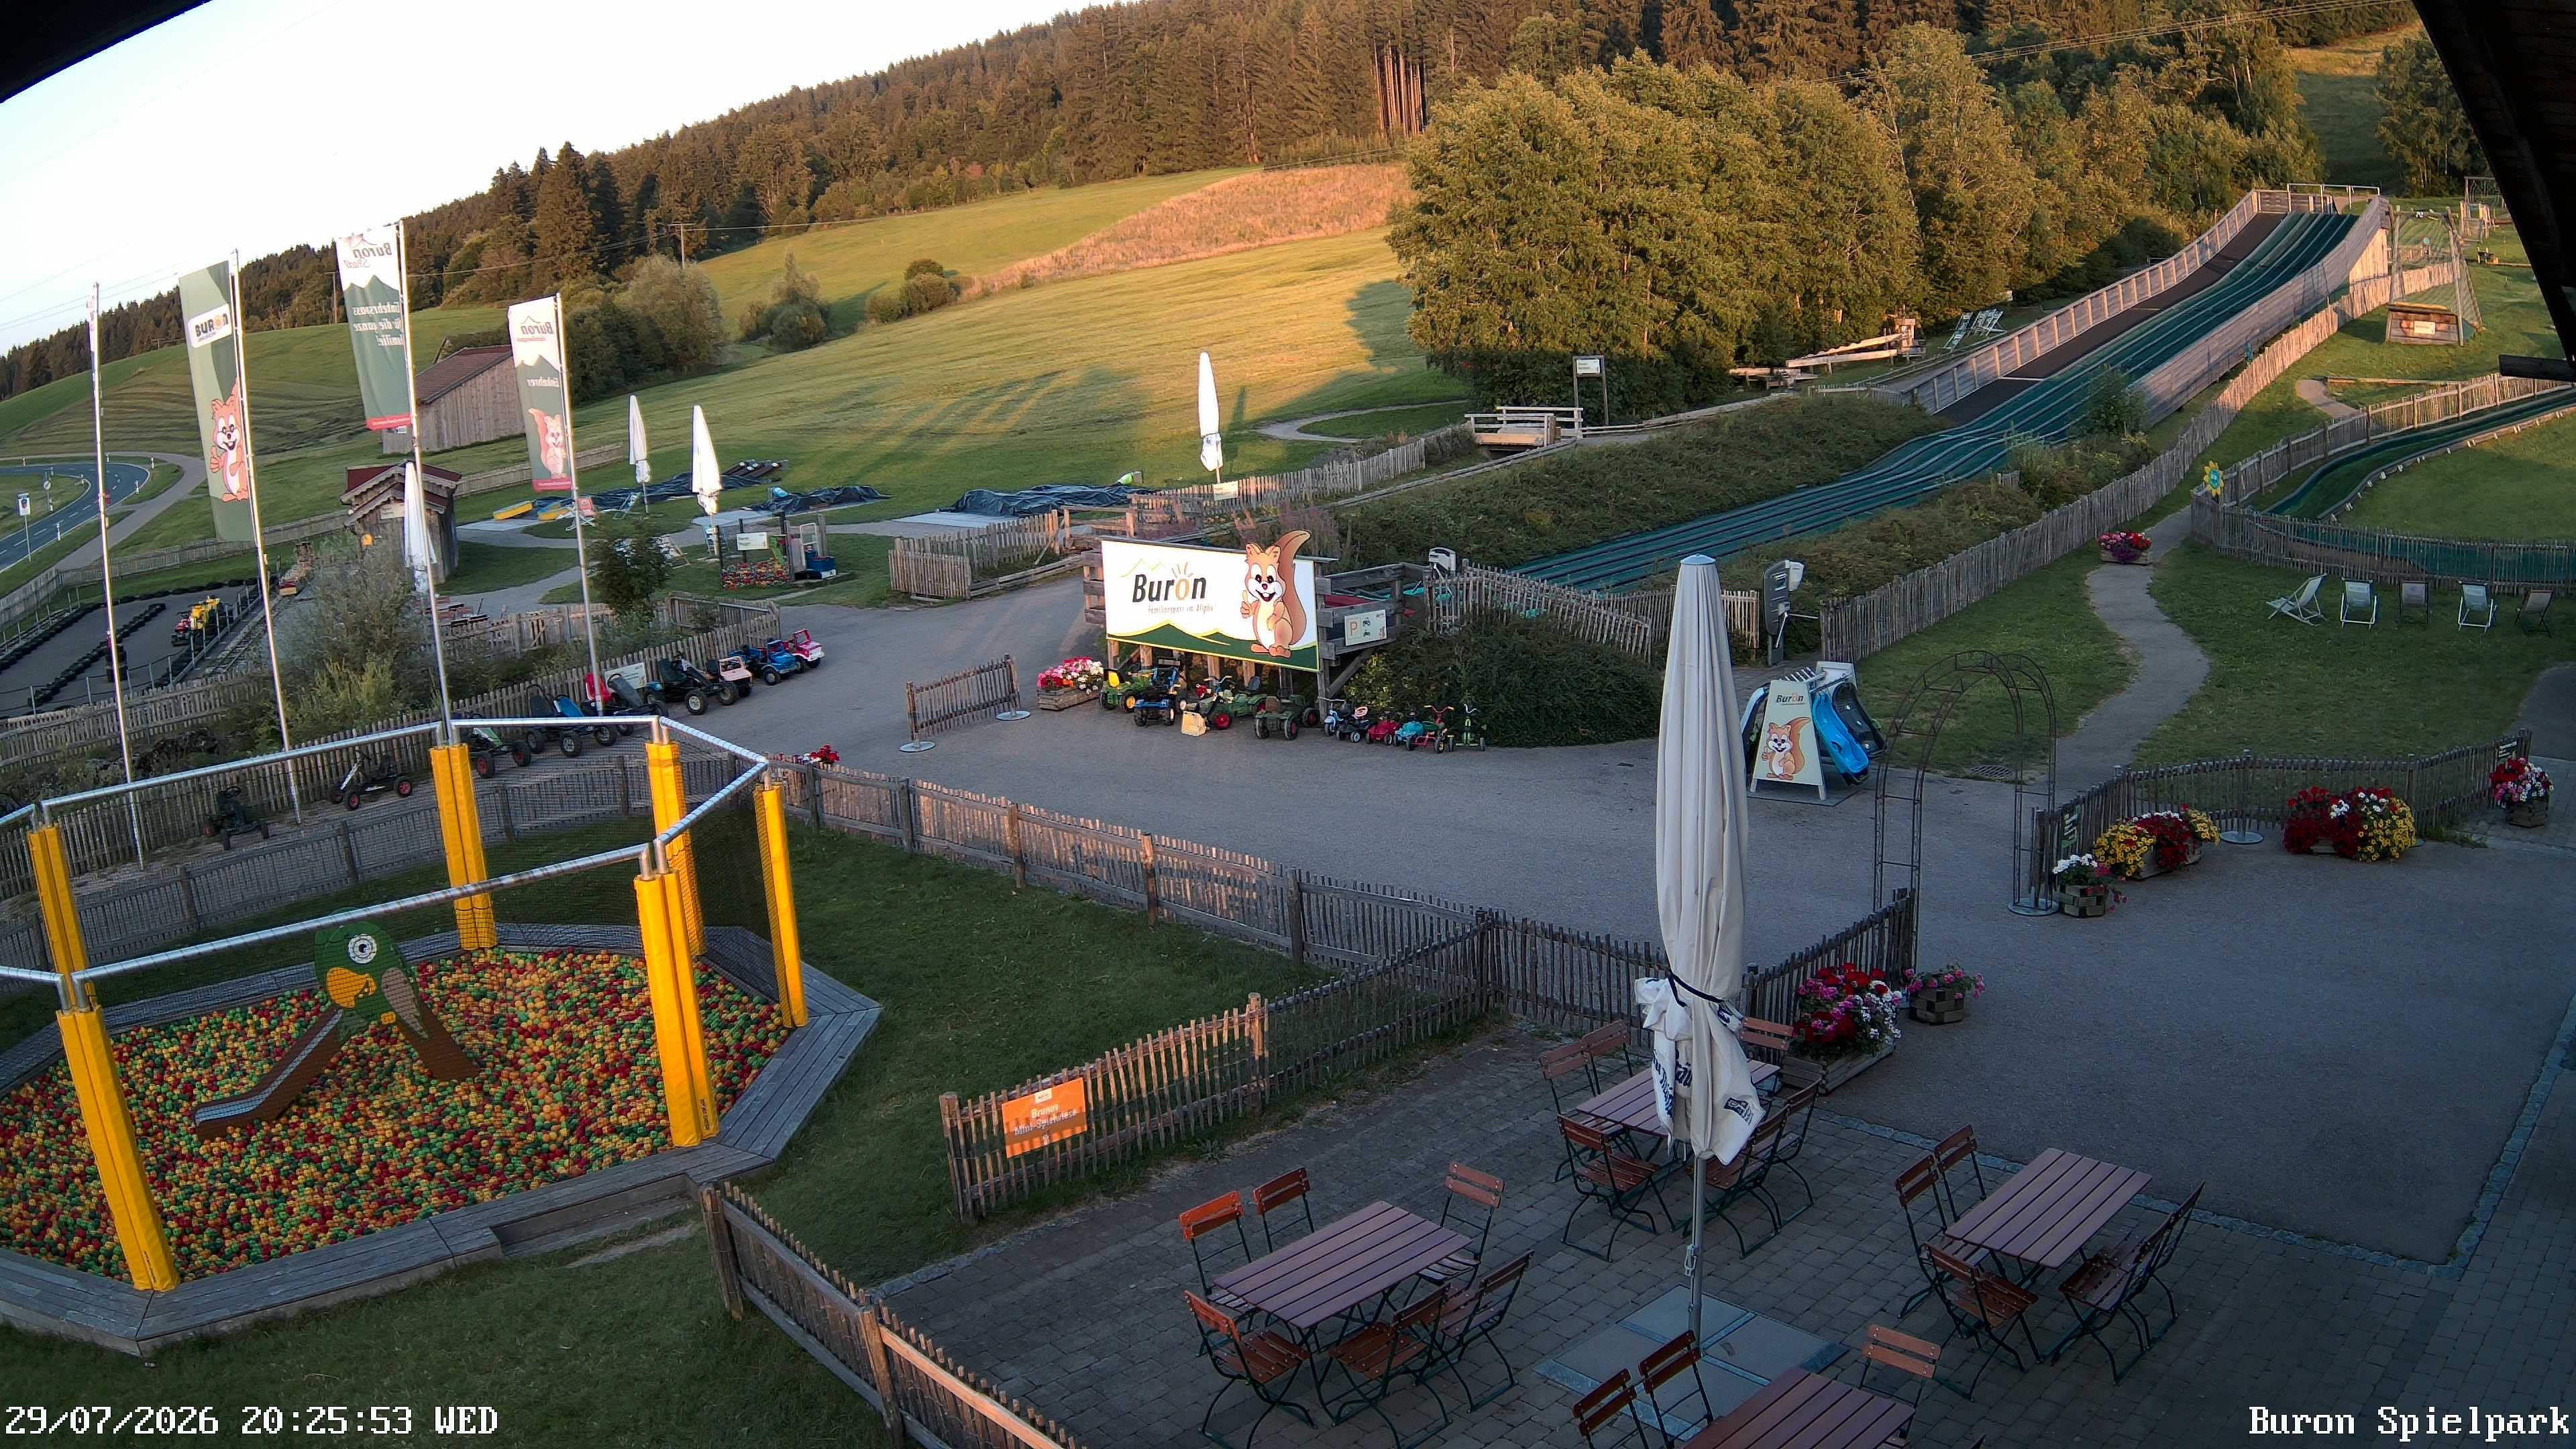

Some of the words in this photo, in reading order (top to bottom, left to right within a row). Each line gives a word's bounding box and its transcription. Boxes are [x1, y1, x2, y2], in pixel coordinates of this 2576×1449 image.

[1132, 574, 1207, 603] Buron
[1350, 621, 1358, 636] P
[1775, 694, 1805, 704] Buron
